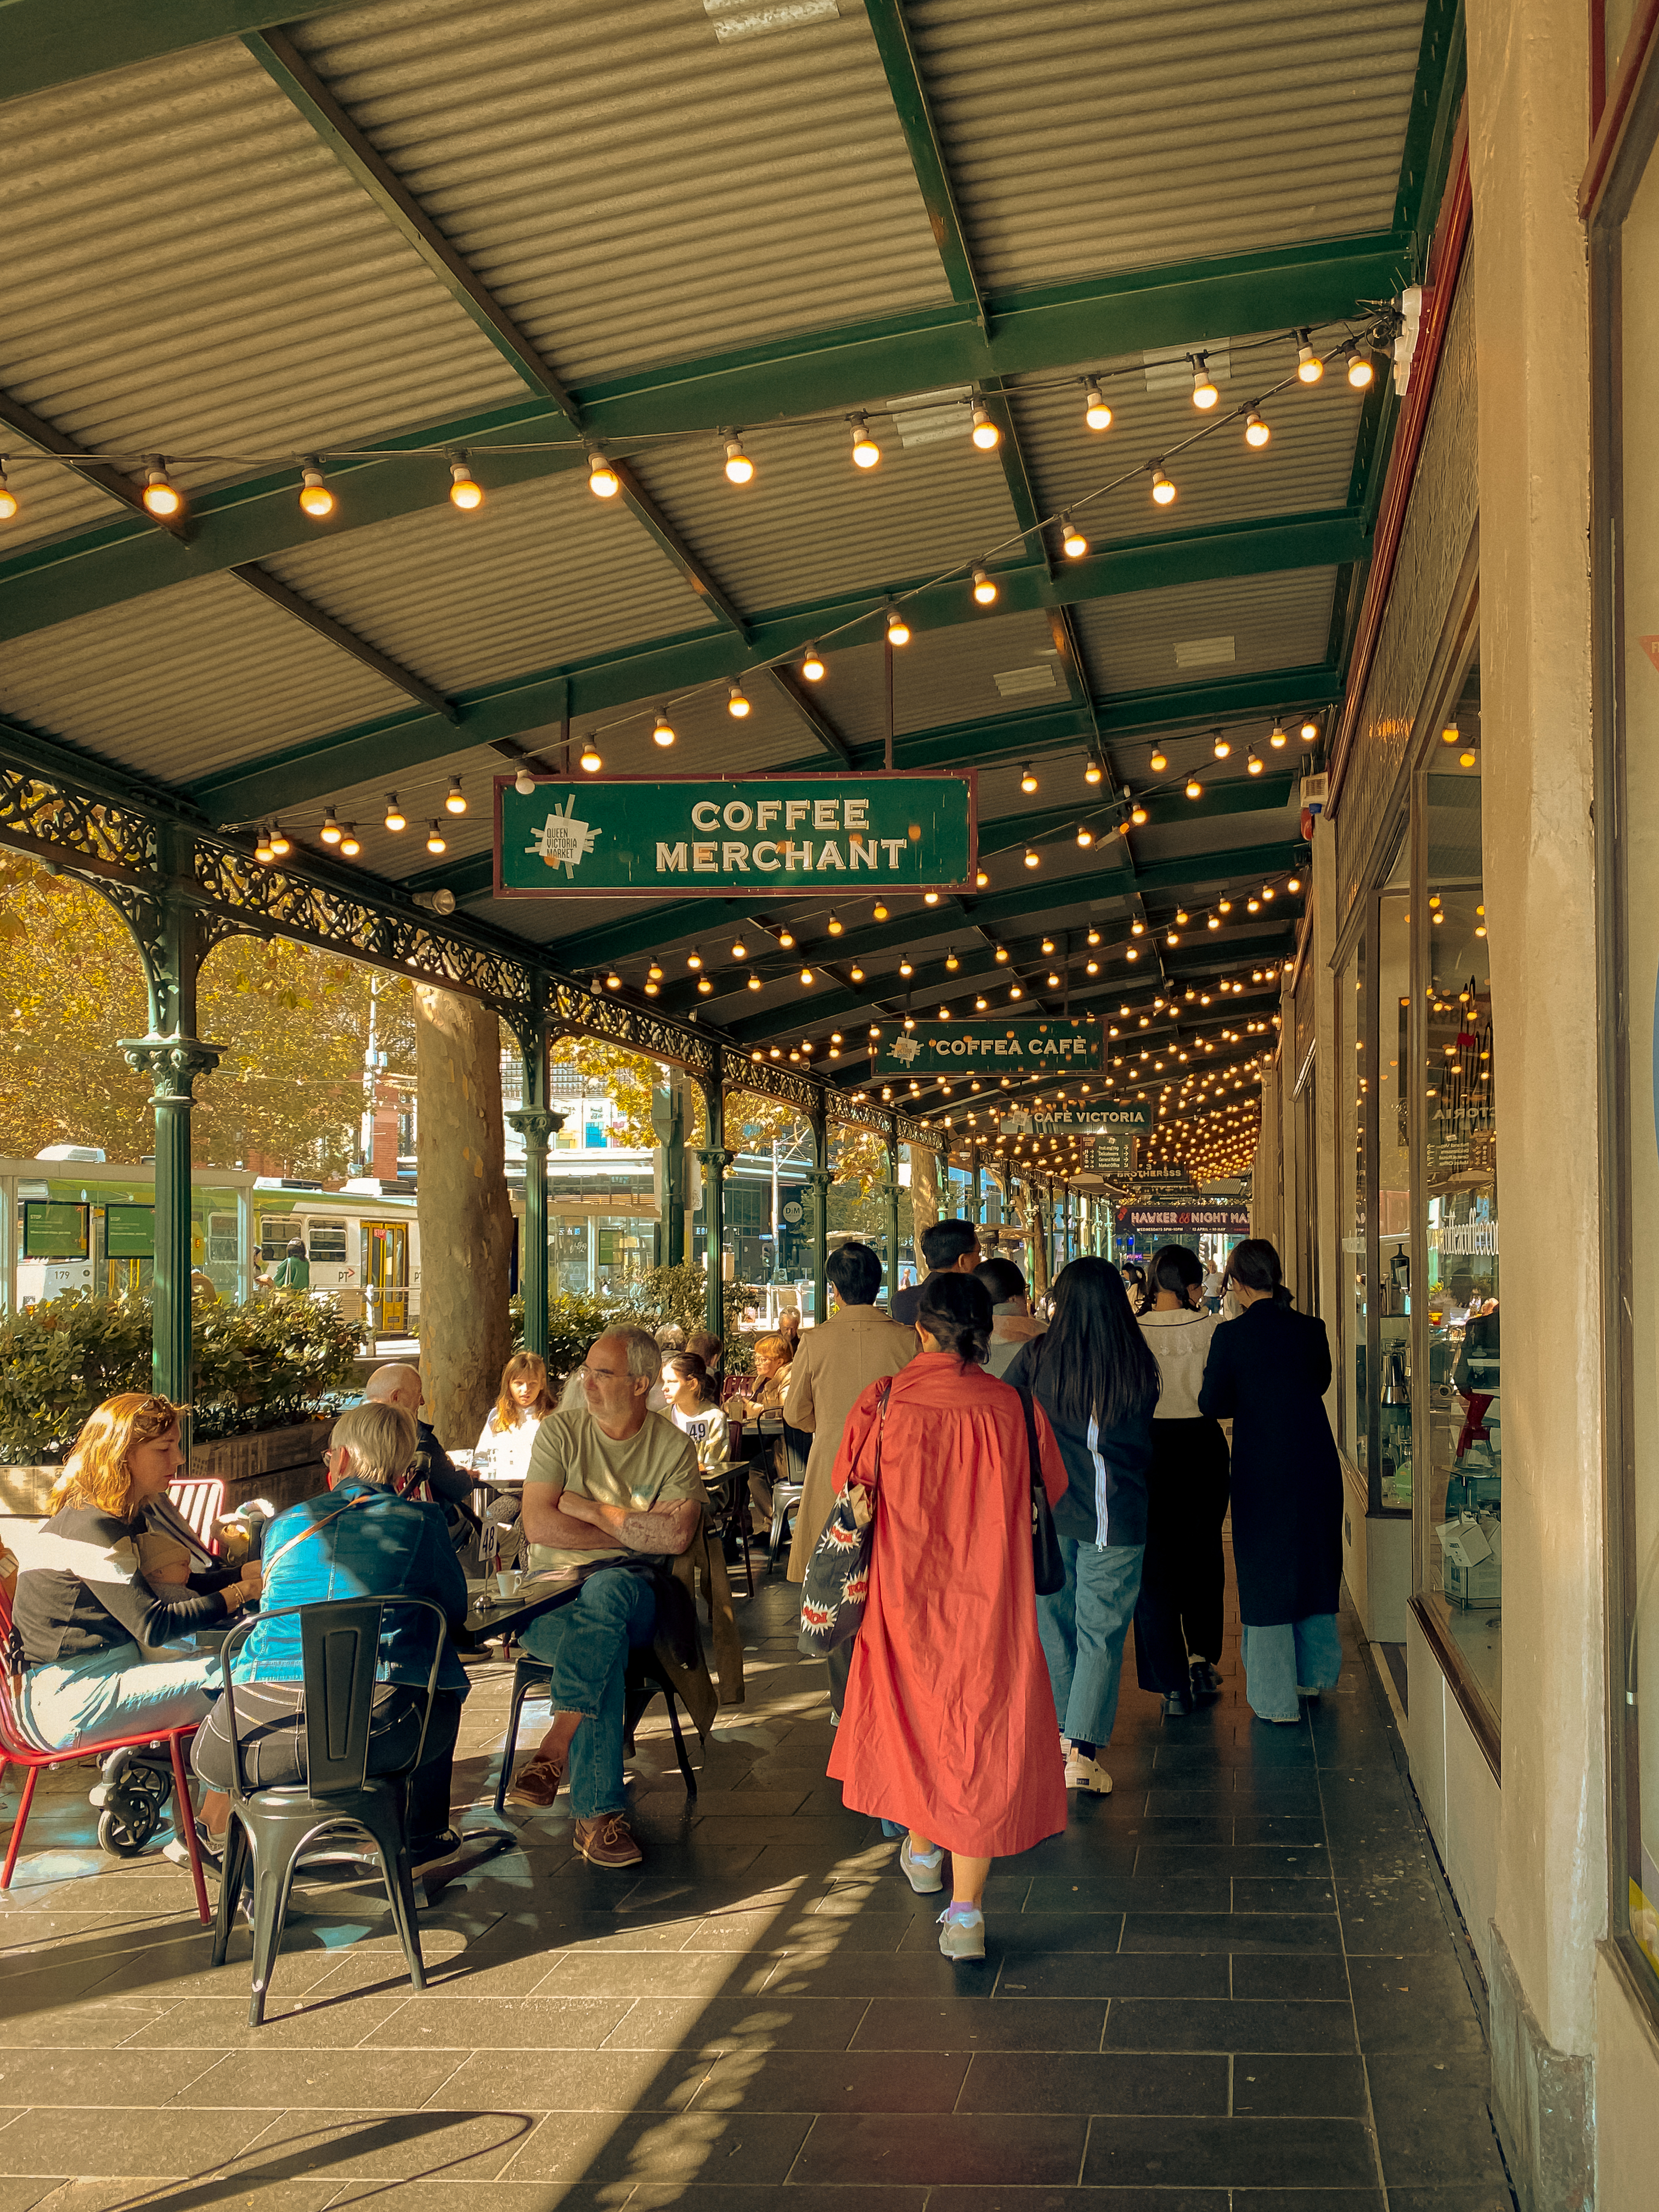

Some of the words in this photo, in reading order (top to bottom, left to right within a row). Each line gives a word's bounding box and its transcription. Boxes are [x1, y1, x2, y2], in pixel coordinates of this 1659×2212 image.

[691, 799, 870, 831] COFFEE
[547, 828, 568, 838] QUEEN
[547, 838, 577, 848] VICTORIA
[547, 849, 573, 859] MARKET
[656, 839, 907, 872] MERCHANT
[936, 1040, 1023, 1056] COFFEA
[1076, 1111, 1144, 1122] VICTORIA
[1131, 1212, 1177, 1223] HAWKER
[1191, 1212, 1228, 1223] NIGHT
[54, 1271, 70, 1279] 179
[690, 1423, 706, 1437] 49
[483, 1526, 494, 1553] 48
